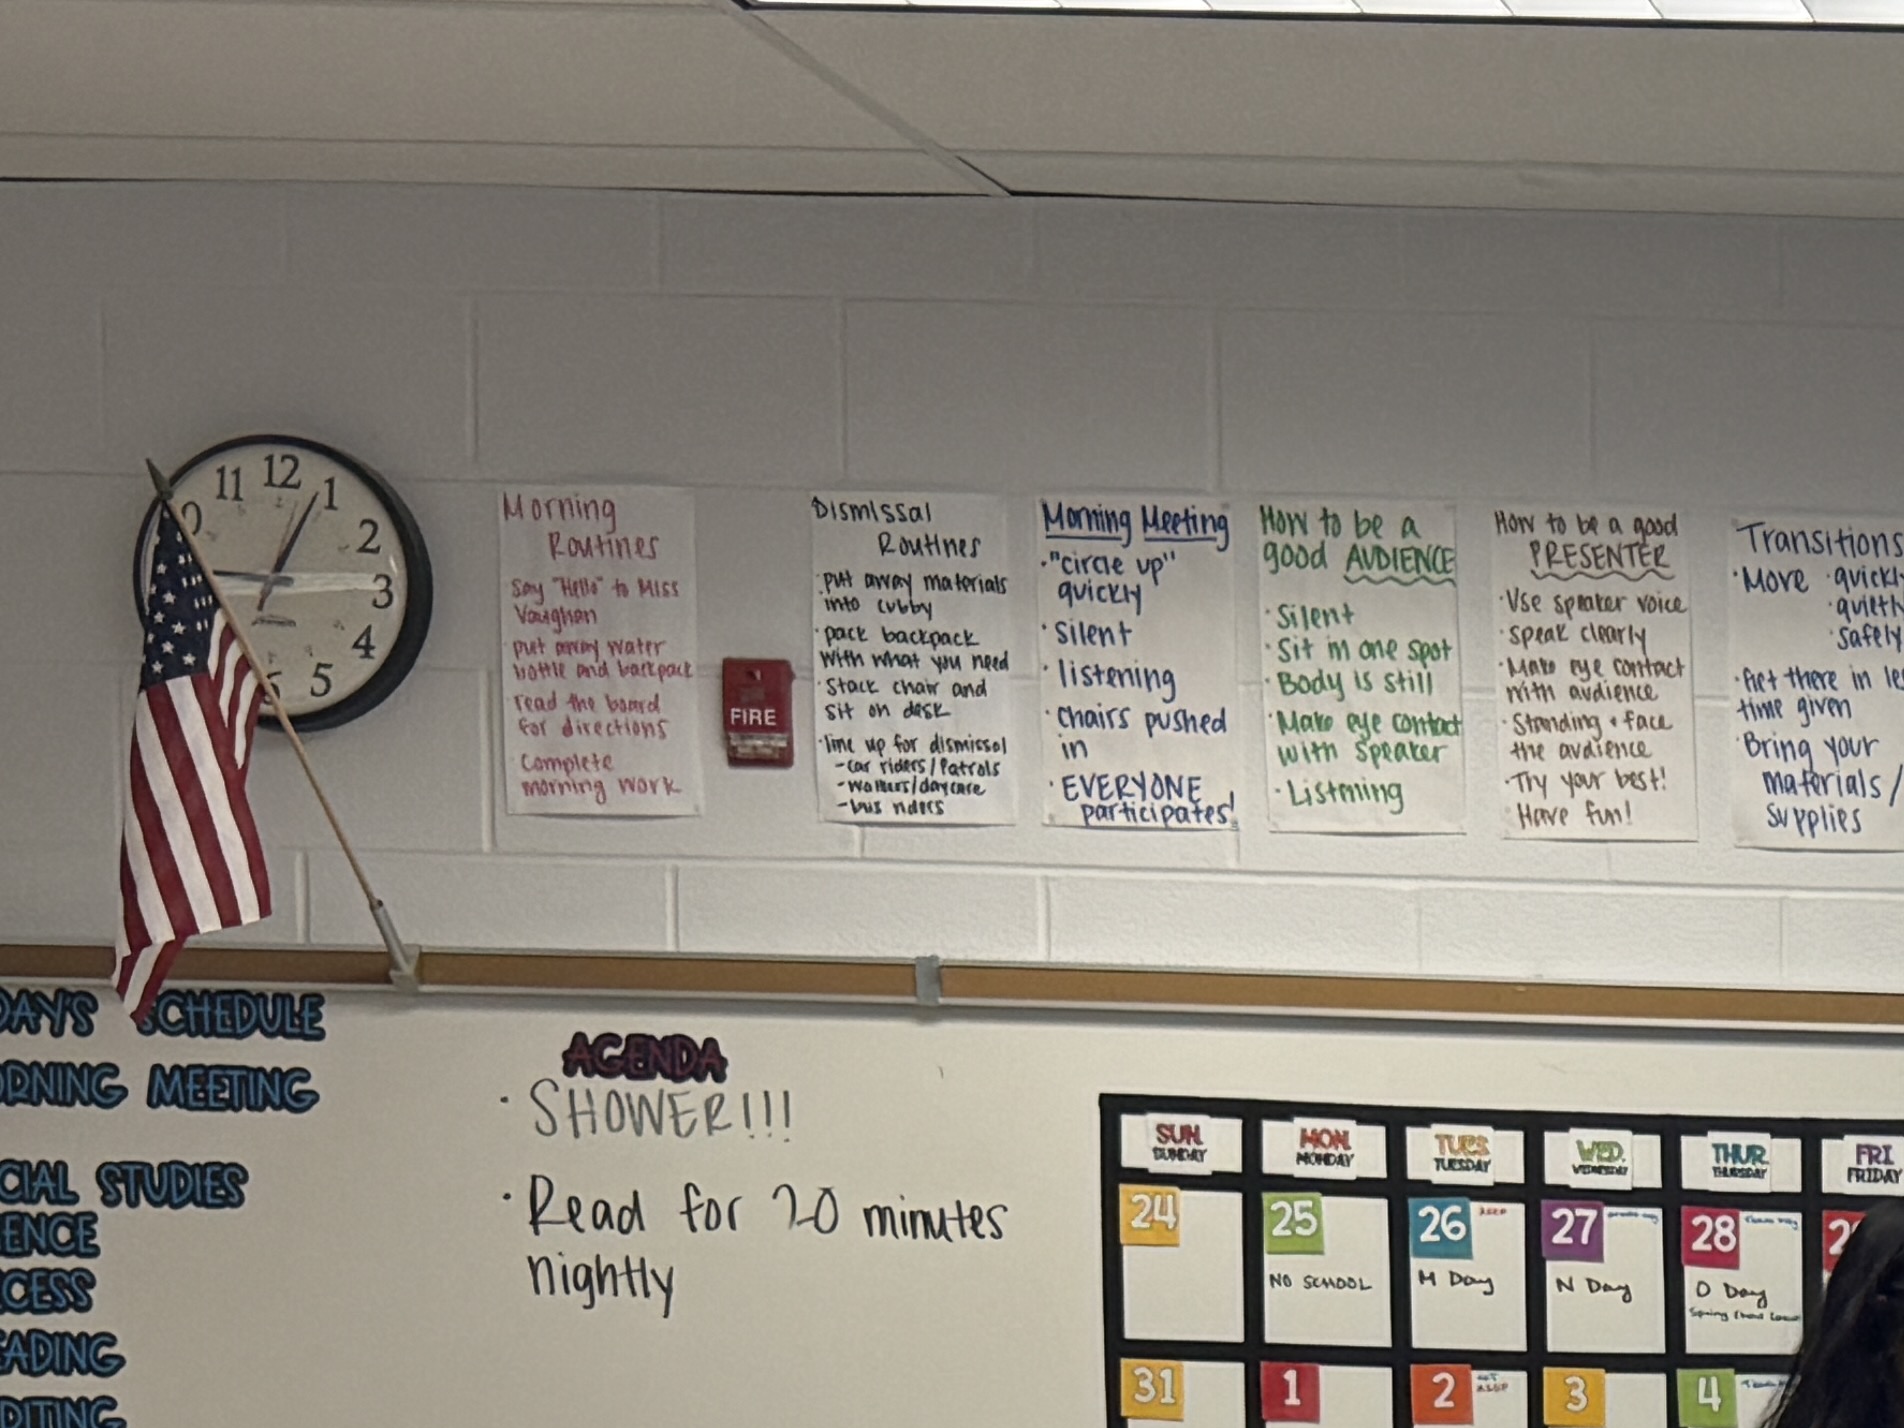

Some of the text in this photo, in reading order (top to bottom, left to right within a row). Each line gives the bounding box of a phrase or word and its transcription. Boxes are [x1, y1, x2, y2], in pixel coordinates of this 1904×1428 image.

[216, 466, 244, 500] 11
[264, 454, 301, 489] 12
[323, 477, 338, 510] 1
[503, 491, 617, 535] Morning
[1042, 502, 1229, 551] Morning Meeting
[1260, 505, 1421, 539] How to be a
[1494, 510, 1678, 545] How to be a good
[357, 519, 381, 553] 2
[548, 531, 660, 560] Routines
[879, 532, 981, 558] Routines
[1736, 522, 1903, 558] Transitions
[1264, 541, 1455, 575] good AUDIENCE
[1530, 540, 1670, 570] PRESENTER
[372, 574, 394, 609] 3
[1743, 566, 1809, 593] Move
[1058, 580, 1141, 616] quickly
[352, 625, 376, 659] 4
[310, 663, 333, 697] 5
[1058, 659, 1176, 704] listening
[1278, 669, 1432, 702] Body is still
[1784, 667, 1837, 691] there
[1850, 665, 1871, 690] in
[730, 708, 777, 726] FIRE
[1145, 708, 1227, 737] pushed
[1737, 696, 1852, 728] time given
[1060, 734, 1088, 760] in
[1744, 731, 1879, 769] Bring your
[1062, 771, 1202, 801] EVERYONE
[562, 1032, 728, 1083] AGENDA
[0, 1060, 320, 1113] RNING MEETING
[529, 1079, 792, 1143] SHOWER!!!
[96, 1160, 249, 1209] STUDIES
[1848, 1167, 1903, 1184] FRIDAY
[528, 1174, 1009, 1244] Read for 20 minutes
[1131, 1194, 1177, 1231] 24
[1270, 1200, 1318, 1236] 25
[1418, 1205, 1467, 1242] 26
[1551, 1208, 1598, 1244] 27
[1691, 1214, 1736, 1252] 28
[527, 1252, 675, 1319] nightly
[1270, 1274, 1372, 1291] NO SCHOOL
[1419, 1271, 1494, 1296] M Day
[1557, 1277, 1632, 1302] N Day
[0, 1329, 125, 1378] ADING
[1132, 1367, 1176, 1404] 31
[1283, 1369, 1301, 1406] 1
[1432, 1372, 1456, 1408] 2
[1564, 1375, 1588, 1412] 3
[1698, 1375, 1721, 1412] 4
